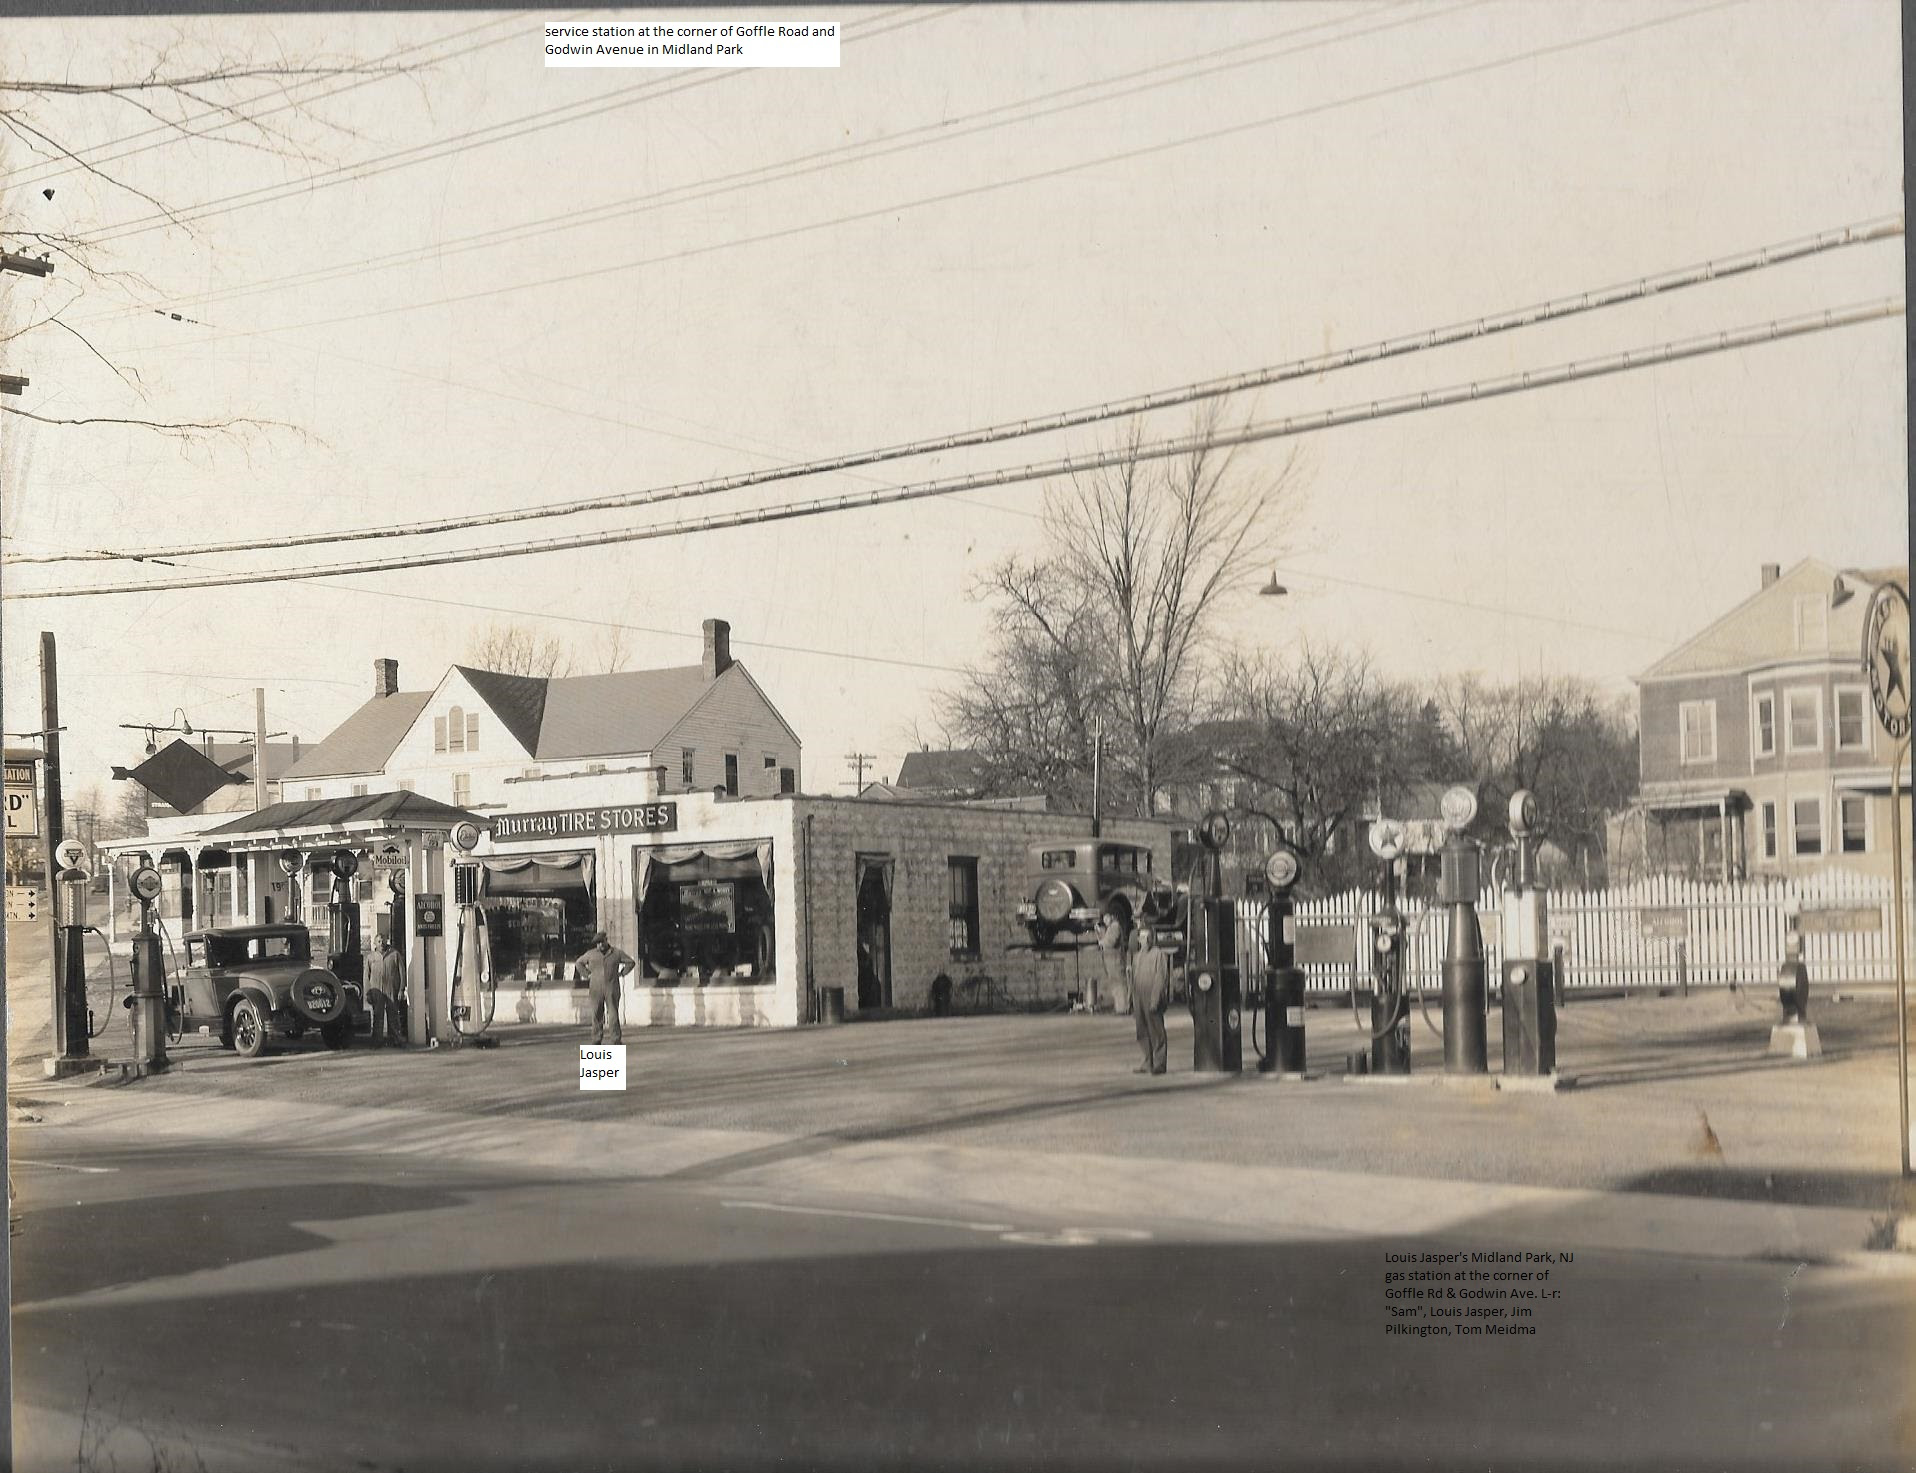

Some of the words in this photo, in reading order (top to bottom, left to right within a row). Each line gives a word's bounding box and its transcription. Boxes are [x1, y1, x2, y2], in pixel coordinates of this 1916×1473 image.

[5, 794, 29, 811] D"
[496, 816, 557, 837] Murray
[559, 811, 596, 832] TIRE
[600, 805, 669, 829] STORES
[375, 854, 407, 866] Mobiloil
